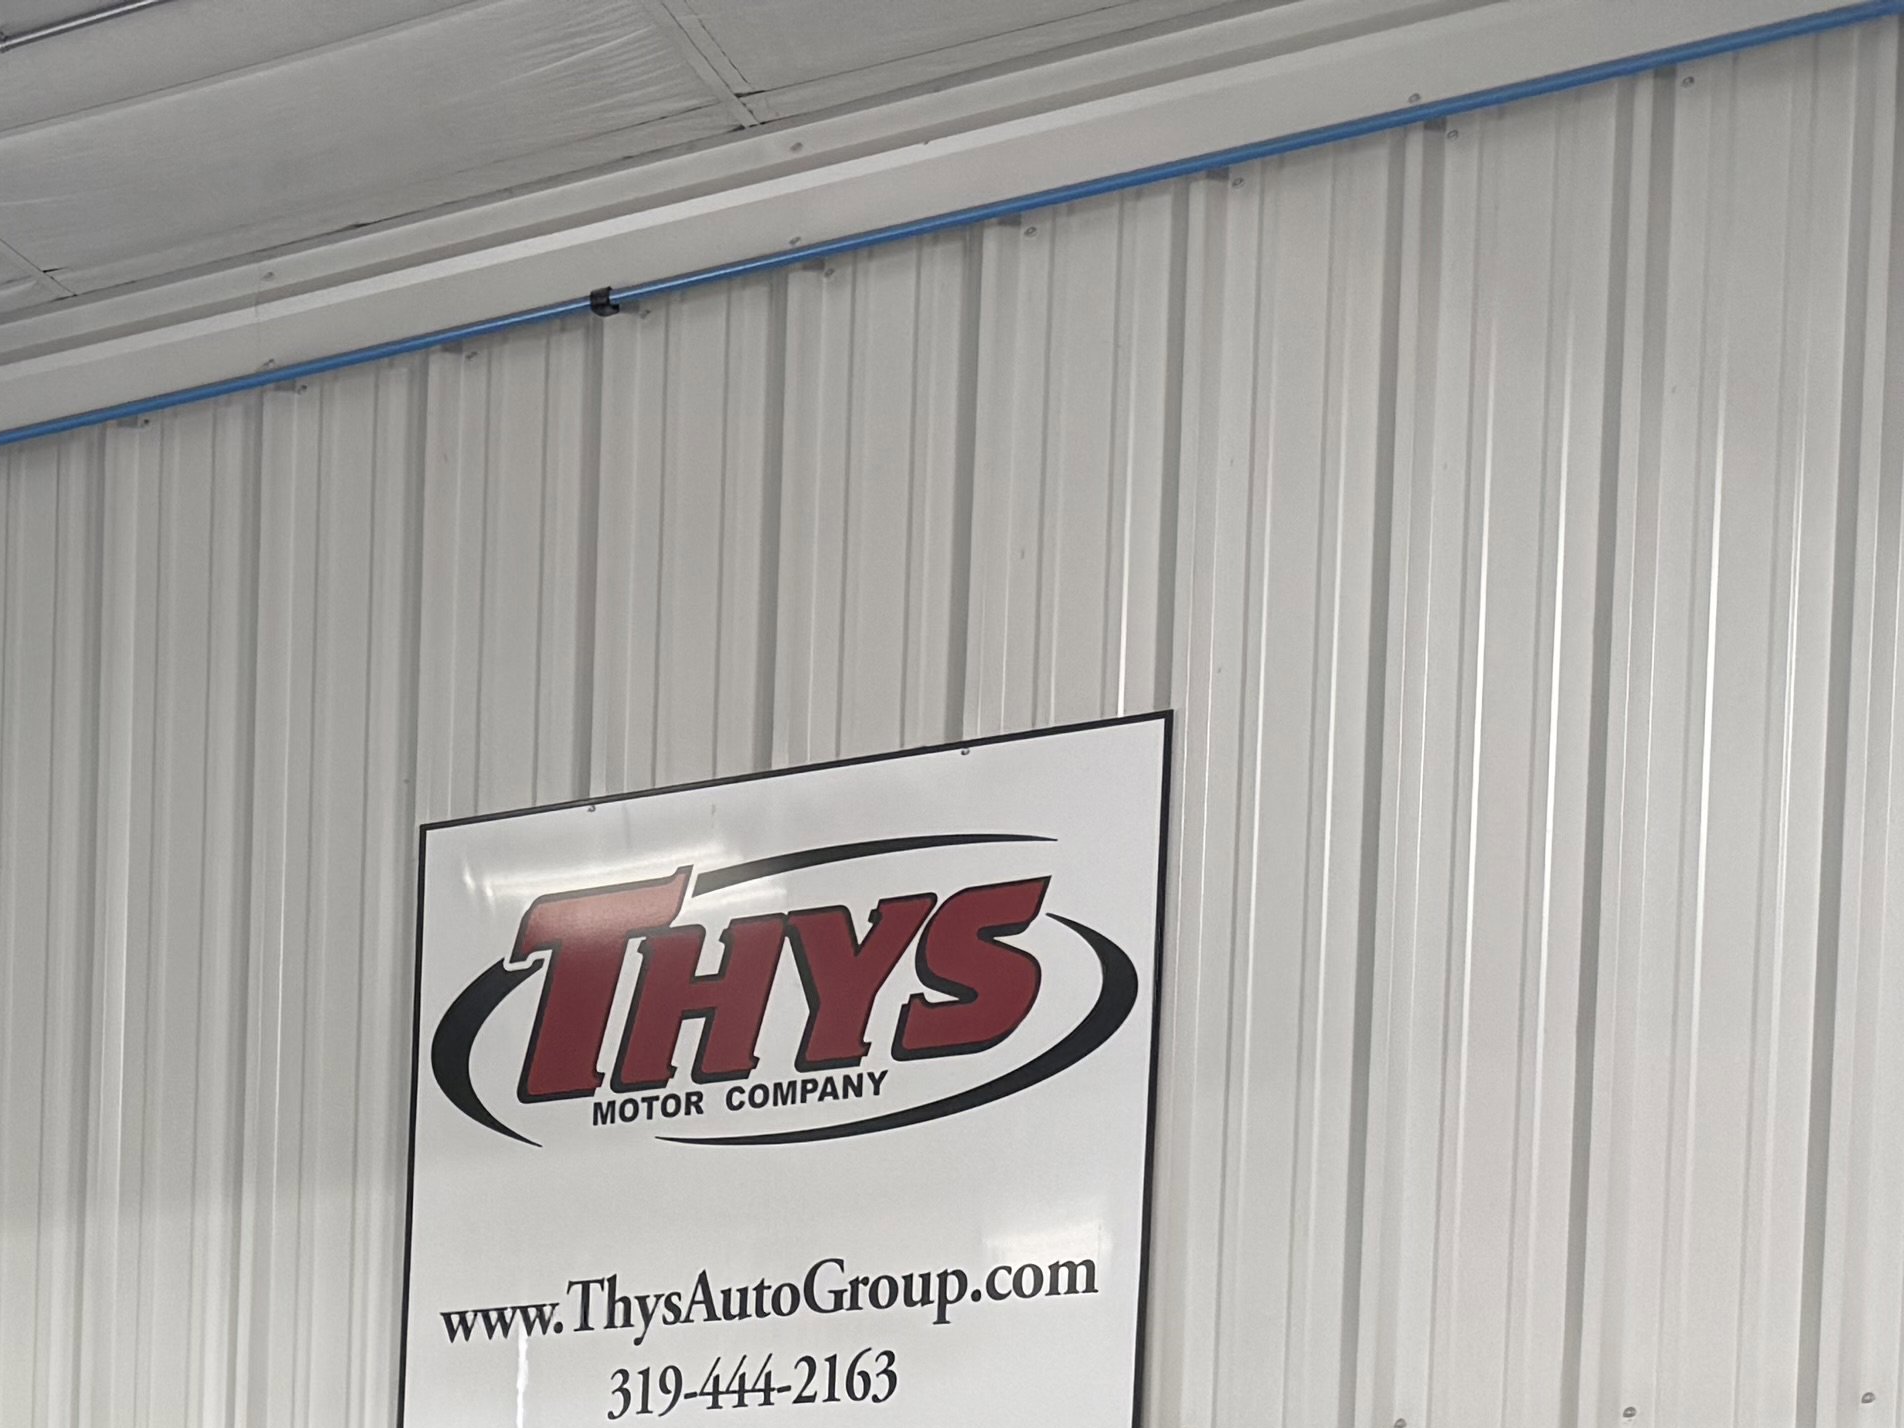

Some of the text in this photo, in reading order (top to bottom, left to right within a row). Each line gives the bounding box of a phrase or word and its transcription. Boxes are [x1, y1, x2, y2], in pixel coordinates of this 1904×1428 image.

[591, 1069, 889, 1126] MOTOR COMPANY
[440, 1254, 1099, 1345] www.ThysAutoGroup.com
[606, 1348, 900, 1421] 319-444-2163
